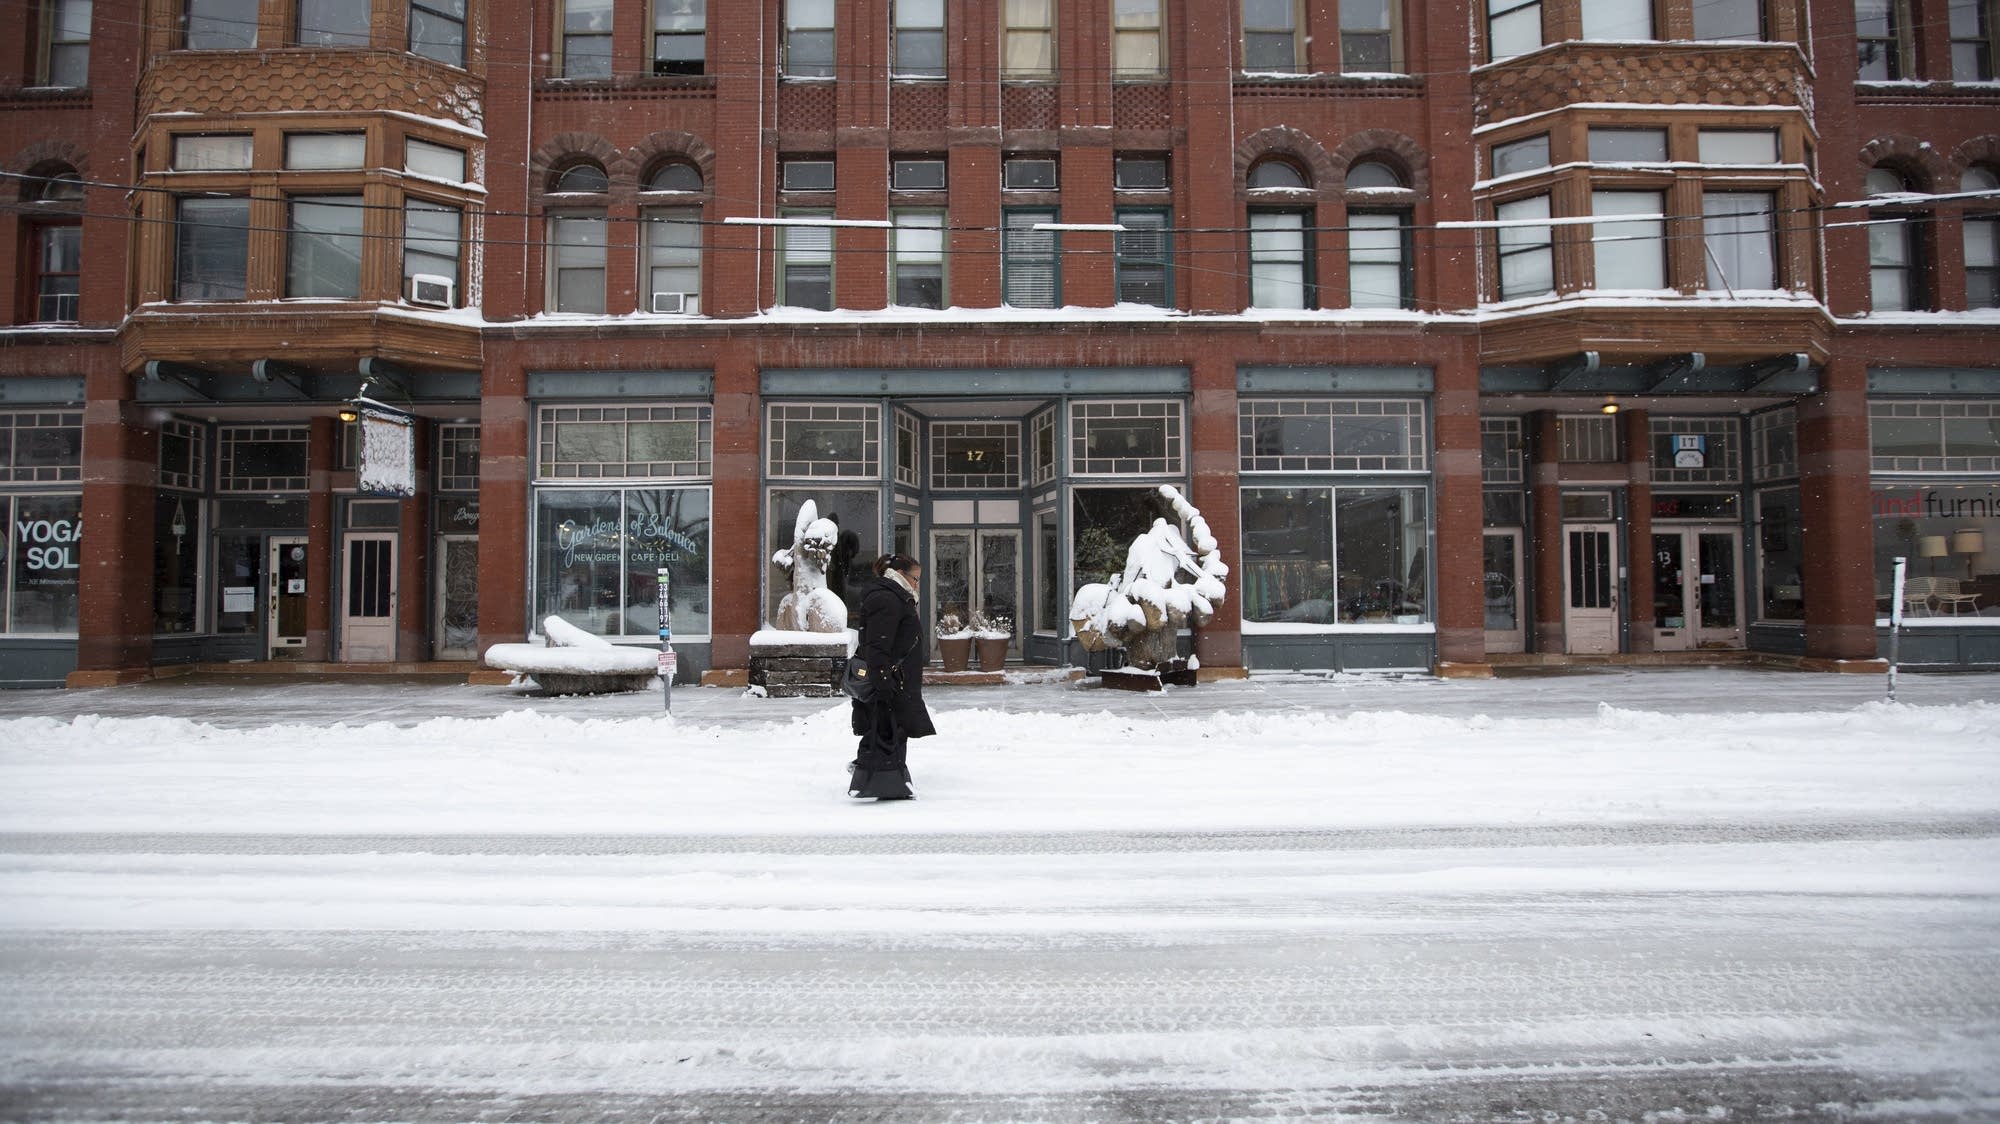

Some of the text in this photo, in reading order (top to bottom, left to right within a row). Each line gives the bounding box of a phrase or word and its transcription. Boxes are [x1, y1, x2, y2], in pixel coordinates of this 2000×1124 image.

[967, 450, 984, 461] 17
[558, 512, 698, 568] Gardens of Salonica
[574, 553, 593, 562] NEW
[1657, 551, 1672, 565] 13
